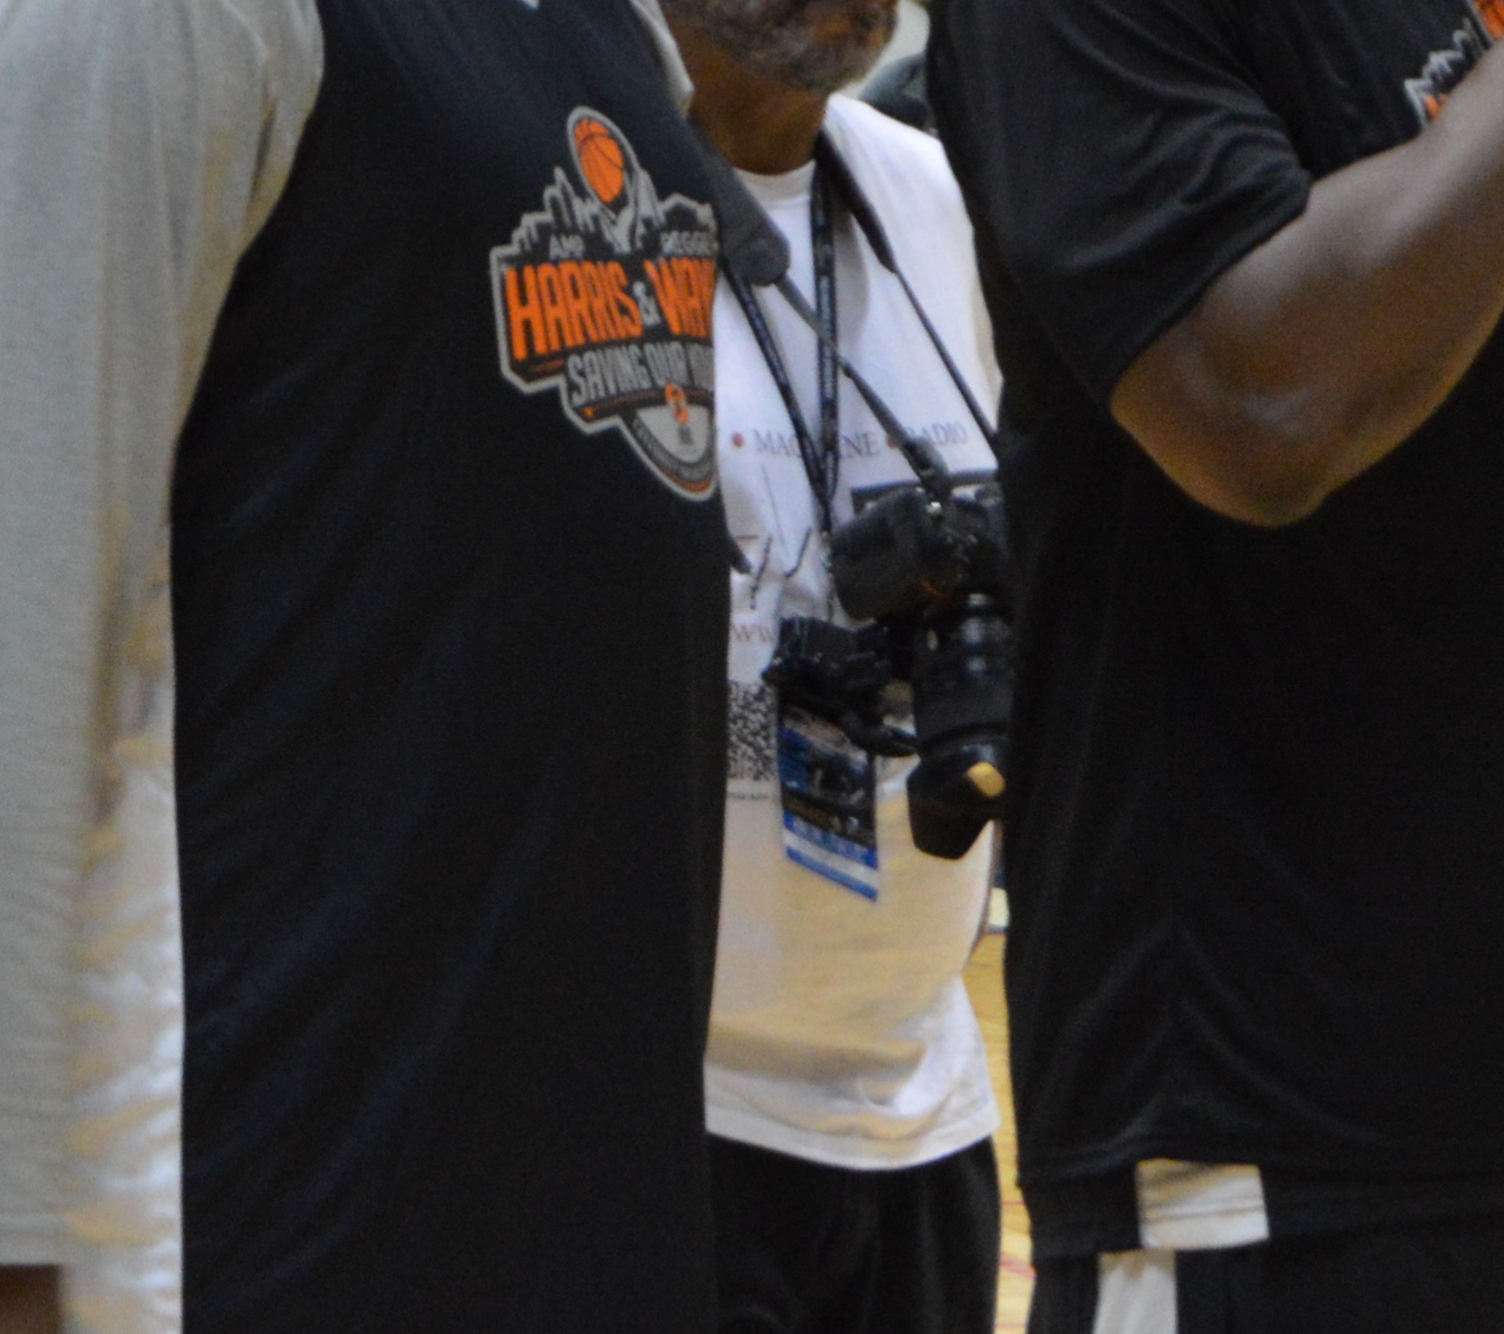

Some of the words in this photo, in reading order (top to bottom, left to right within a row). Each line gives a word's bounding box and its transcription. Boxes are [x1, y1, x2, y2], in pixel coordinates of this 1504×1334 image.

[503, 260, 643, 360] HARRIS
[632, 280, 661, 327] &
[567, 343, 653, 408] SAVING
